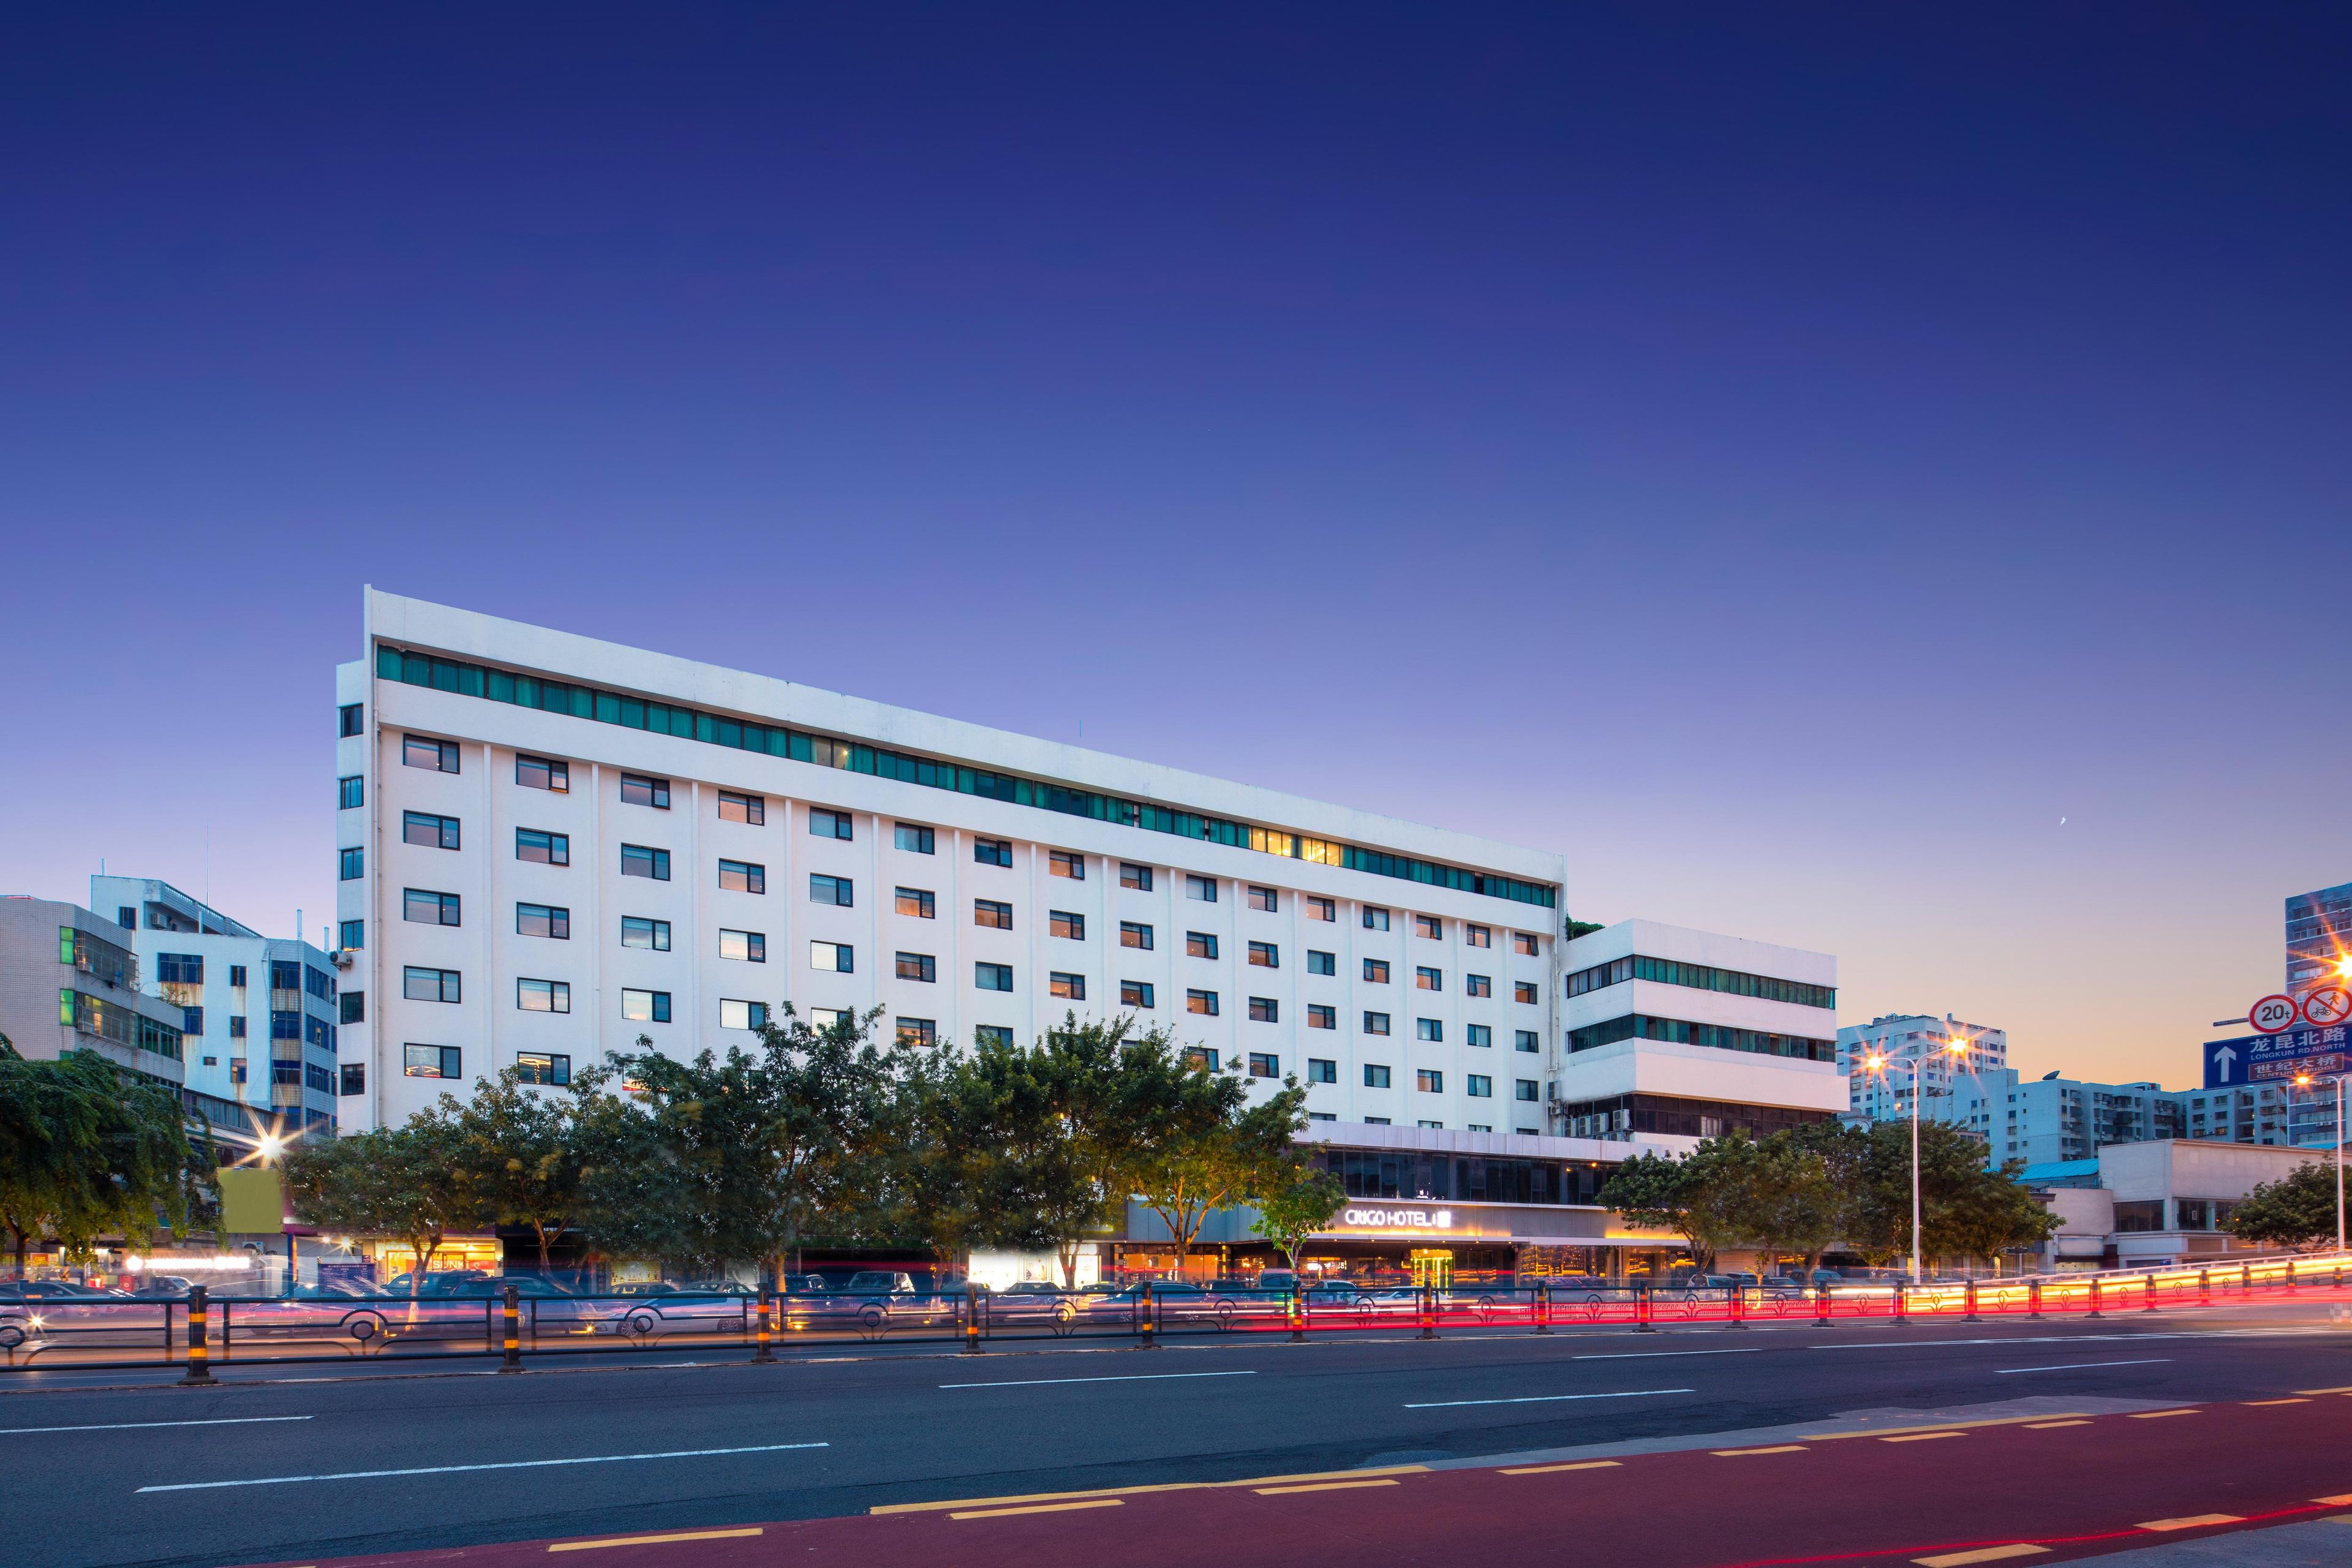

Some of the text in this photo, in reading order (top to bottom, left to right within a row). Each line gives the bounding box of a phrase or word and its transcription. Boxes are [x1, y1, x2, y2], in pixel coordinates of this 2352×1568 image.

[2250, 1027, 2346, 1053] 龙昆北路
[2250, 1042, 2345, 1060] LONGKUN RD.NORTH
[2255, 1055, 2336, 1074] 世纪大桥
[1387, 1211, 1433, 1227] HOTEL
